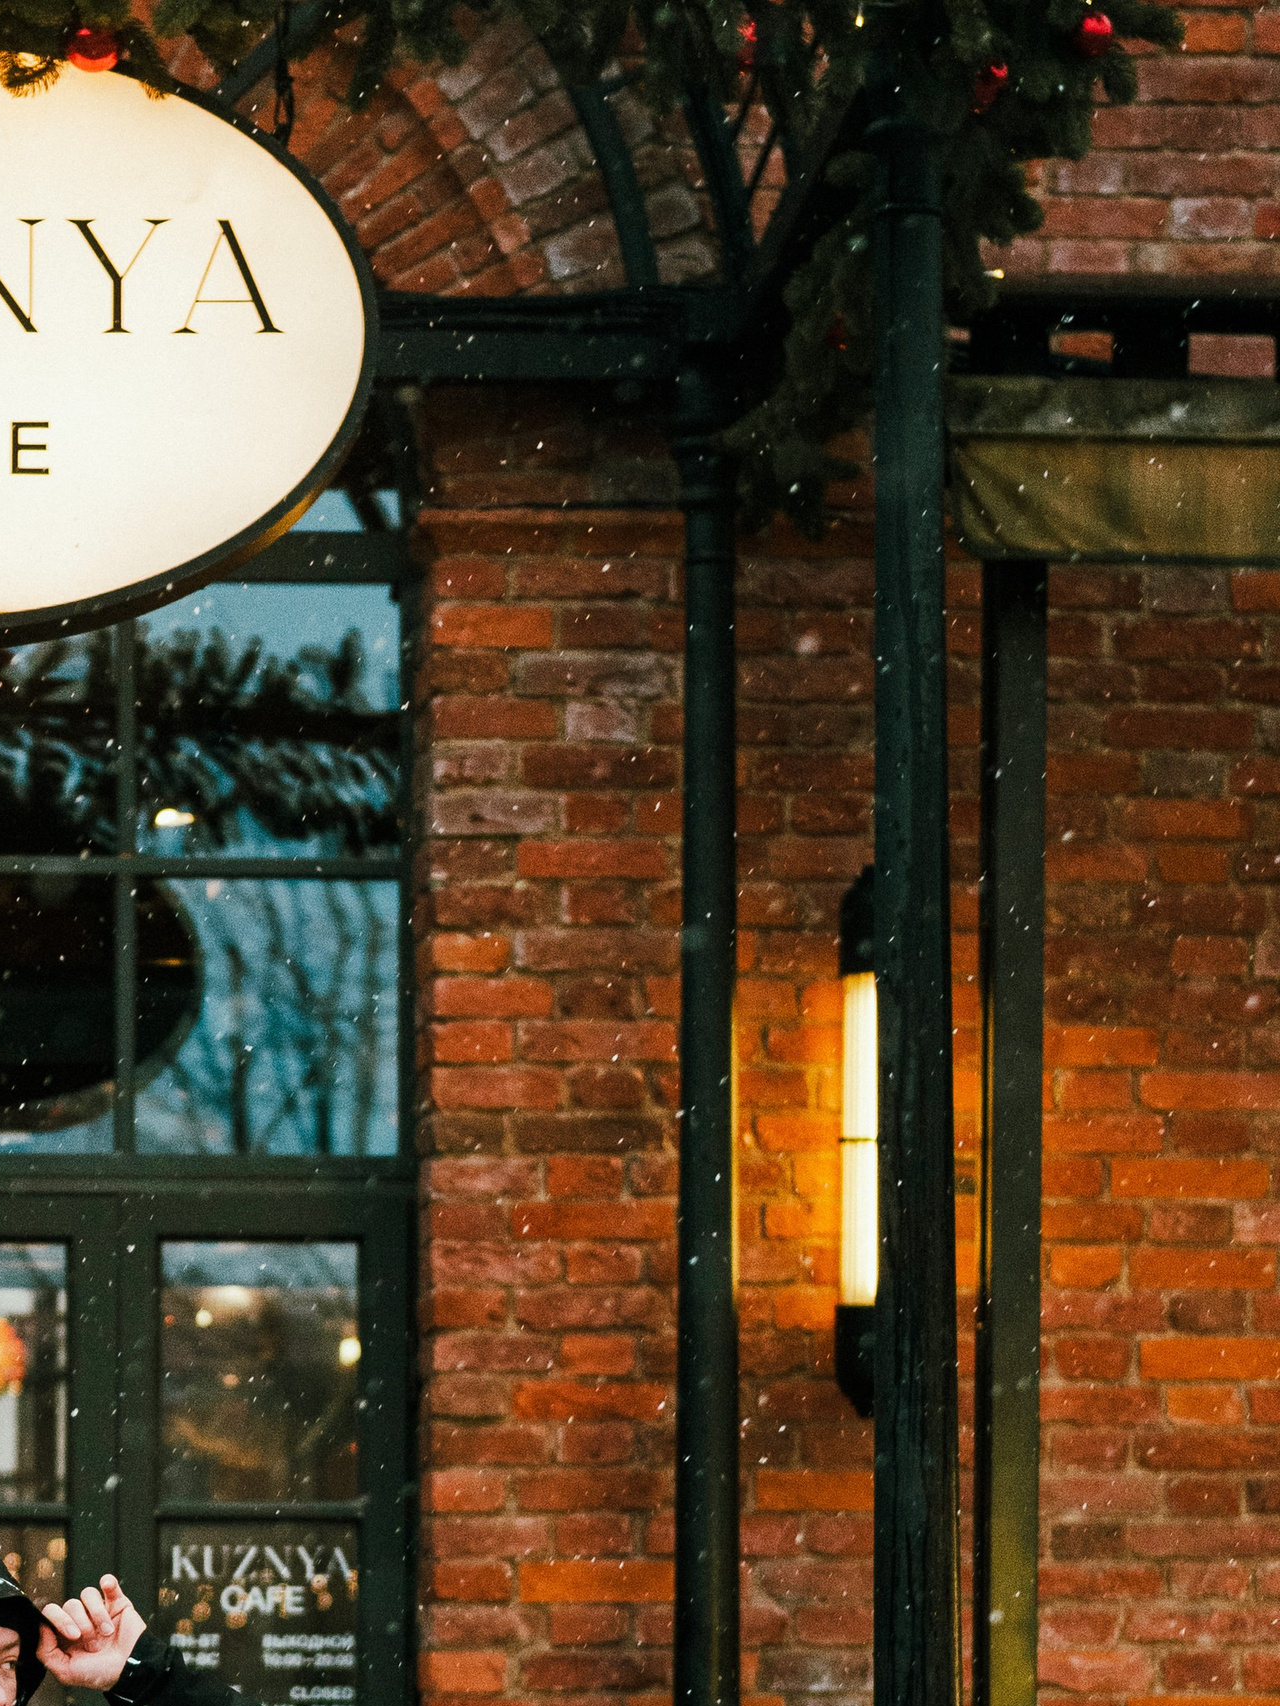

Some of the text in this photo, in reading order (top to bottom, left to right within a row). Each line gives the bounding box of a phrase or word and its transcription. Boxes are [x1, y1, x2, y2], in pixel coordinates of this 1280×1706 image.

[171, 1545, 356, 1582] KUZNYA
[220, 1584, 305, 1616] CAFE
[289, 1685, 355, 1700] CLOSED
